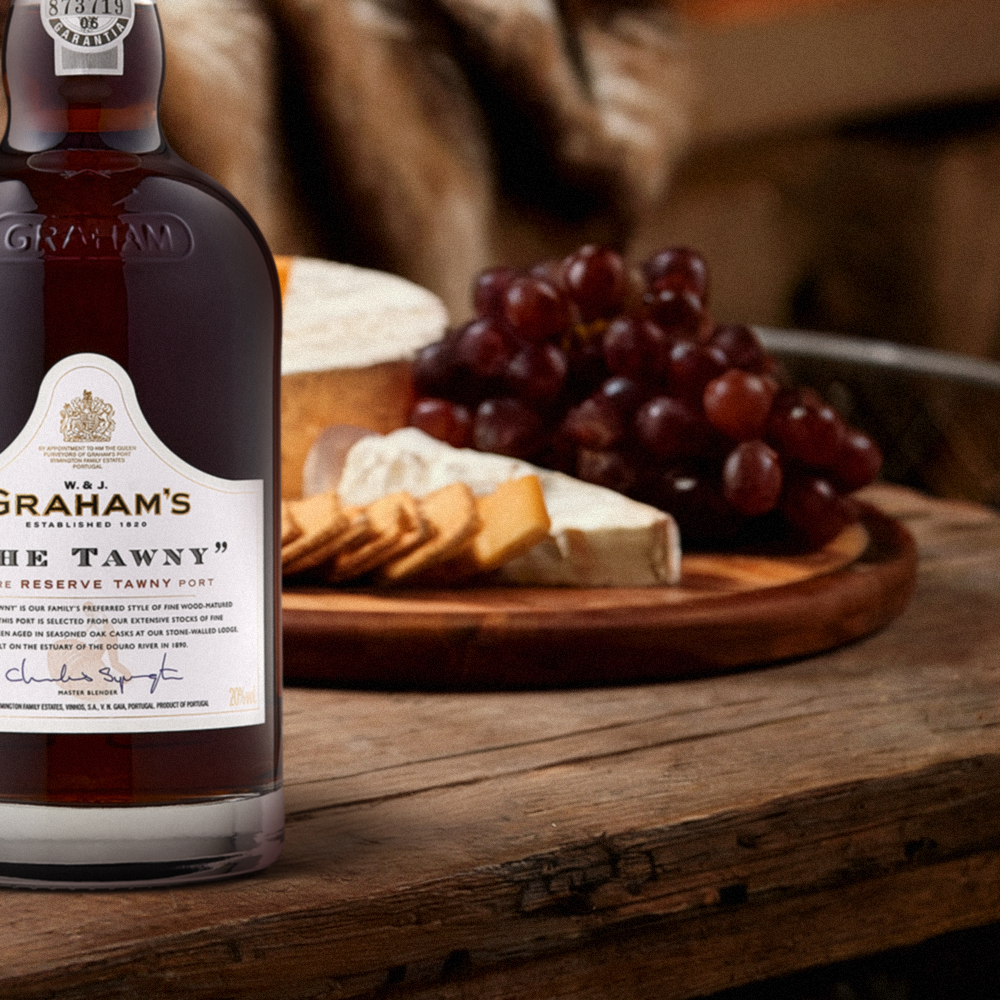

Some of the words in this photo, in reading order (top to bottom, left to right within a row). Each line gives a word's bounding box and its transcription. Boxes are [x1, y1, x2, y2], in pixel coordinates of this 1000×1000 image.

[80, 16, 99, 29] 06
[53, 22, 125, 46] GARANTIA
[4, 223, 173, 251] GRAHAM
[64, 481, 80, 489] W.
[82, 481, 93, 489] &
[97, 481, 108, 489] J.
[20, 579, 102, 589] RESERVE
[113, 578, 171, 589] TAWNY
[178, 578, 215, 588] PORT
[181, 601, 233, 610] WOOD-MATURED
[166, 627, 217, 636] STONE-WALLED
